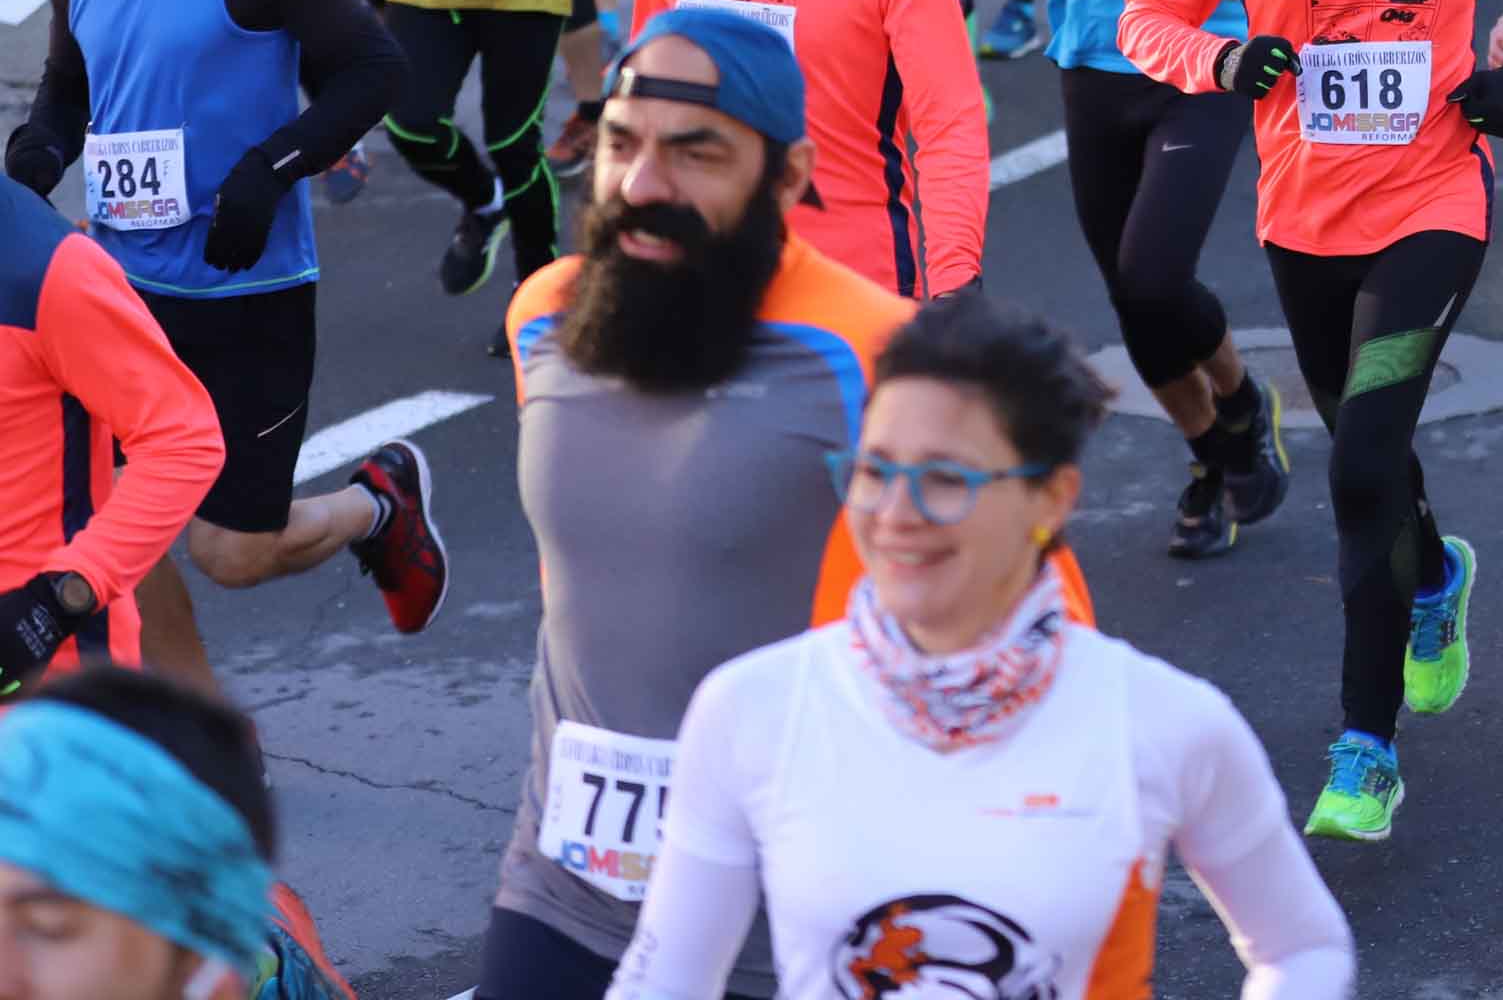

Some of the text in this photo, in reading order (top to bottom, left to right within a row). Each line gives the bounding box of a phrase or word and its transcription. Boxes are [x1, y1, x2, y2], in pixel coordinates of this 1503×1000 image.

[1344, 50, 1371, 66] CROSS
[1373, 49, 1427, 65] CABRERIZOS
[1321, 68, 1403, 111] 618
[1307, 113, 1420, 132] JOMISAGA
[98, 157, 161, 198] 284
